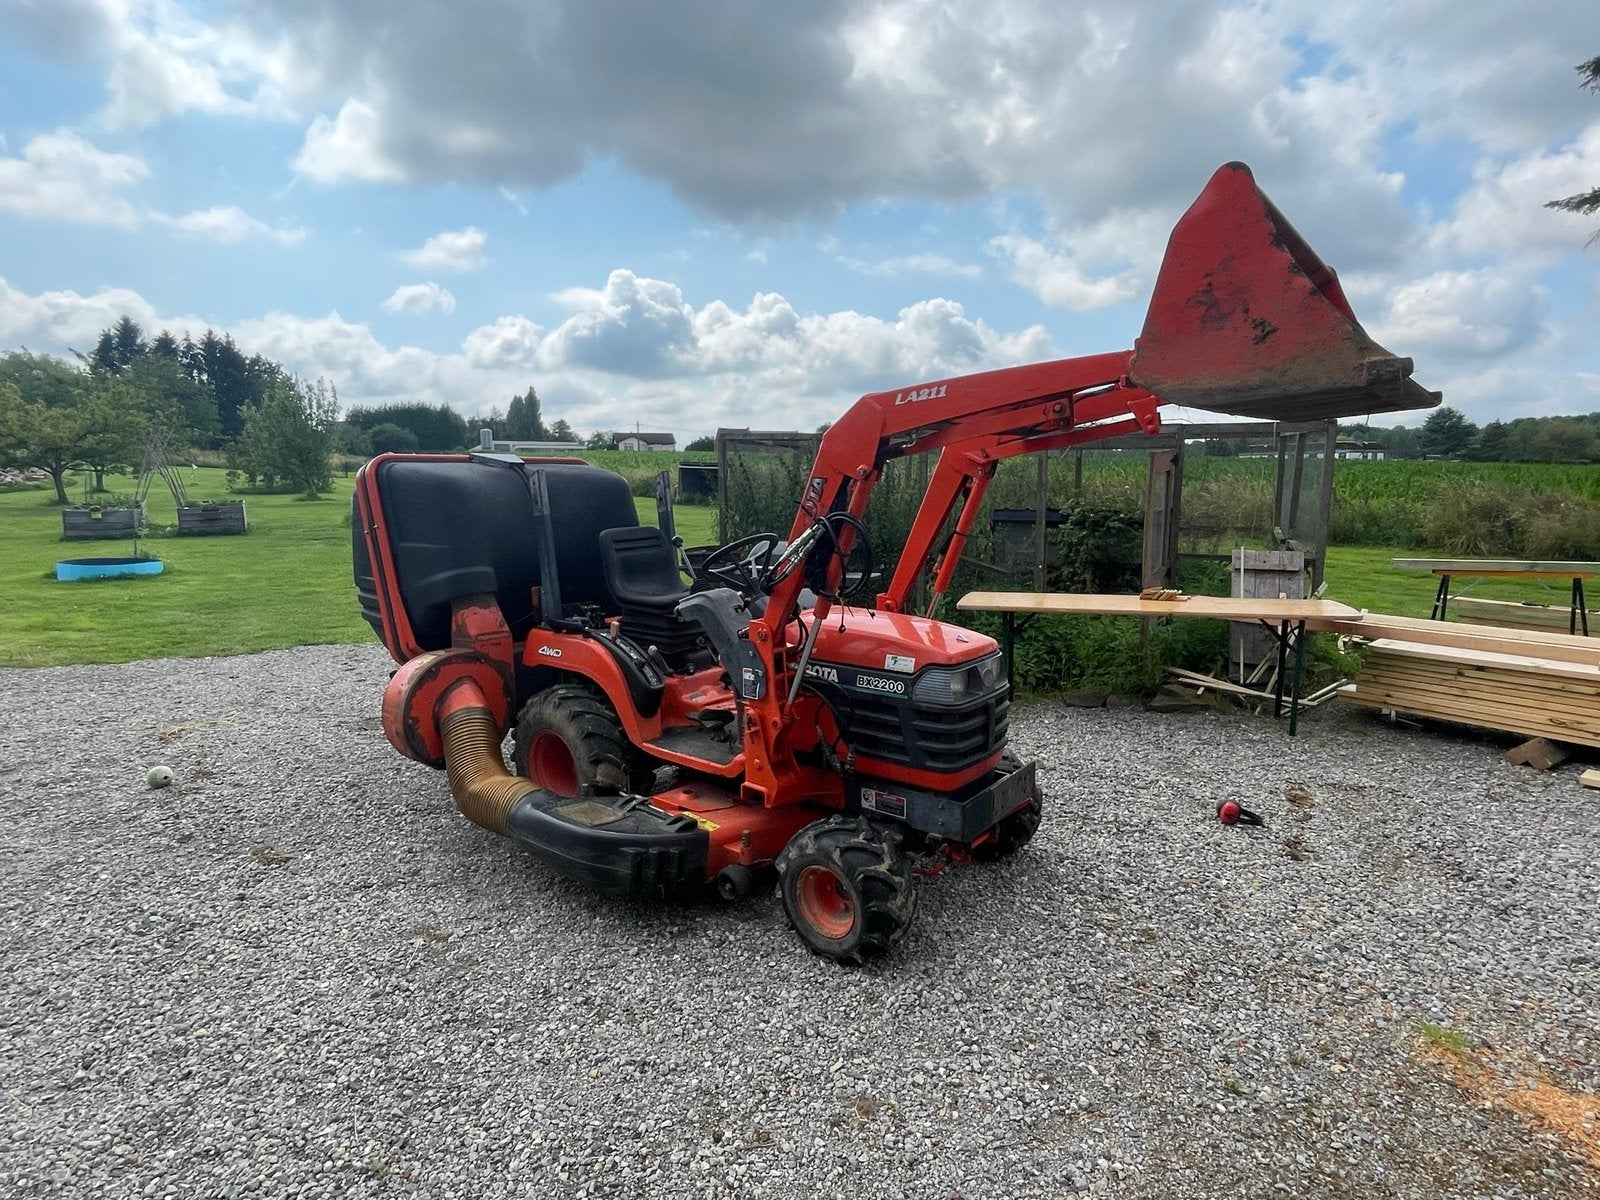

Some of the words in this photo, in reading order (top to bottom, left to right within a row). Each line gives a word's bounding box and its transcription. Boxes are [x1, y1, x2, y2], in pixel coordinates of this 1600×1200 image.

[895, 384, 948, 406] LA211
[538, 645, 562, 658] 4WD
[857, 675, 905, 694] BX2200
